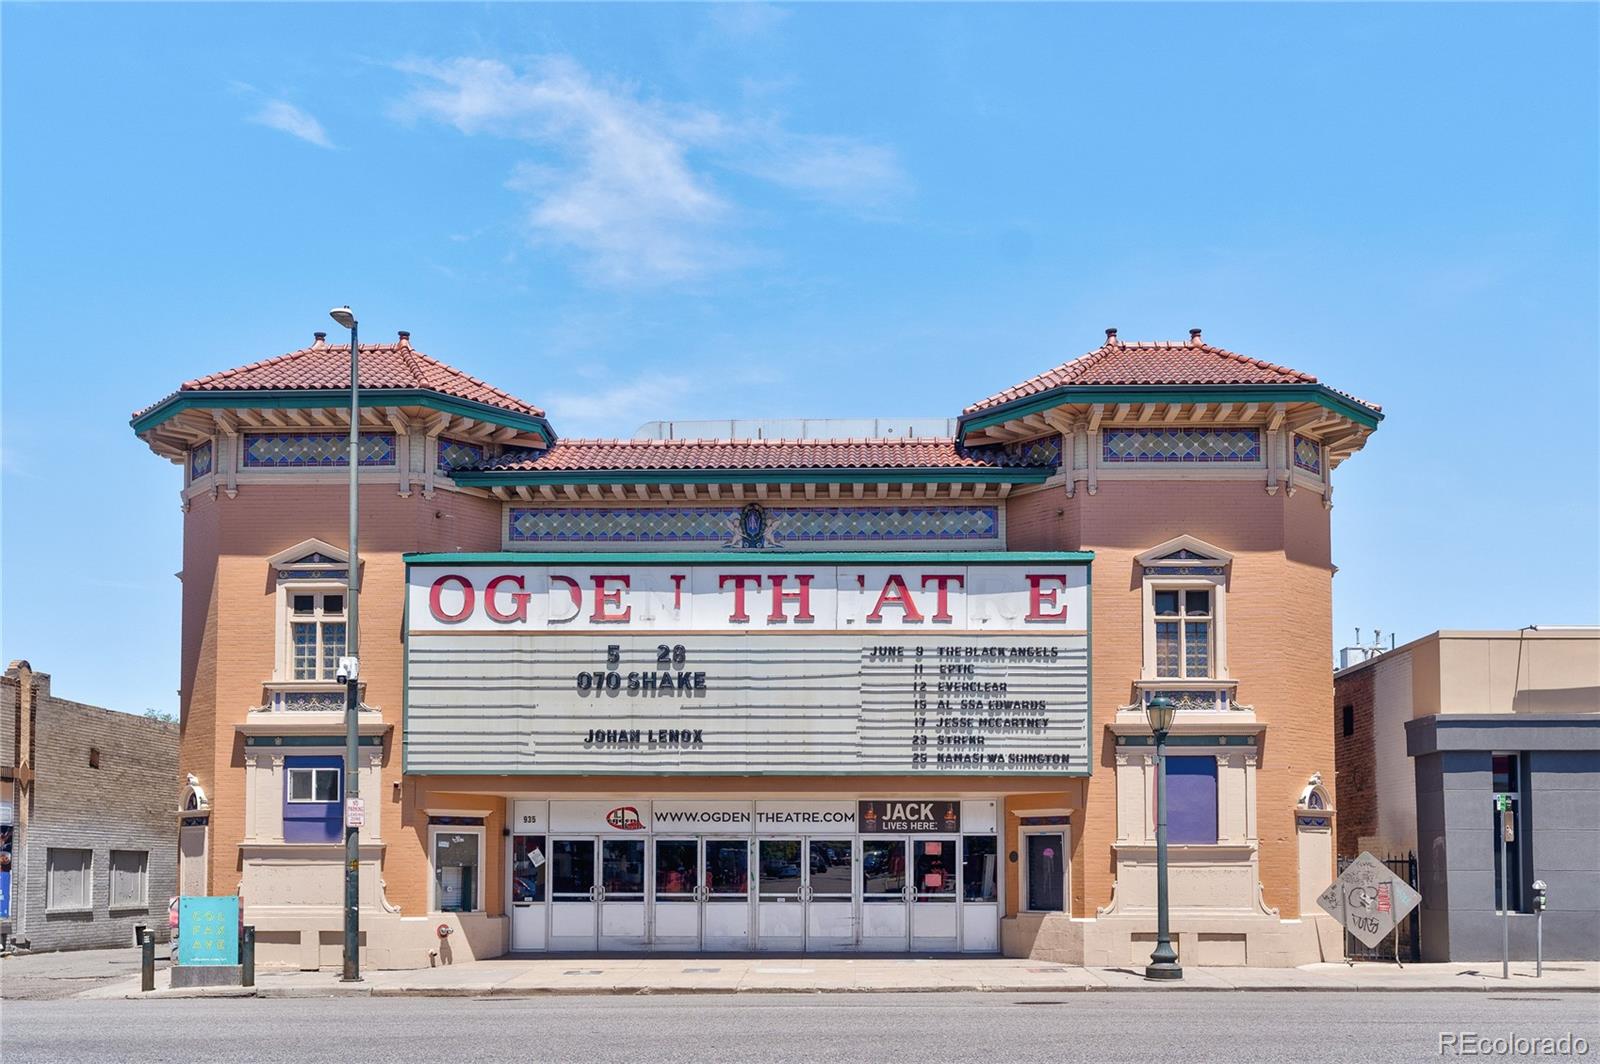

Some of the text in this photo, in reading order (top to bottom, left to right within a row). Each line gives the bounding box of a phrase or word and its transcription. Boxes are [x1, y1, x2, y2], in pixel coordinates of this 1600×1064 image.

[429, 574, 1068, 623] OGDE THATE
[607, 644, 686, 664] 5 28
[870, 646, 1058, 657] JUNE 9 THE BLACK ANGELS
[914, 664, 975, 675] 11 EPTIC
[627, 671, 707, 691] SHAKE
[913, 682, 1008, 693] 12 EVERCLEAR
[914, 700, 927, 710] 15
[988, 700, 1047, 711] EDWARDS
[914, 718, 1050, 729] 17 JESSE MCCARTNEY
[584, 729, 704, 743] JOHAN LENOX
[911, 735, 928, 746] 23
[911, 753, 928, 764] 25
[936, 753, 984, 764] KAMASI
[881, 802, 935, 821] JACK
[523, 815, 537, 824] 935
[882, 821, 908, 830] LIVES
